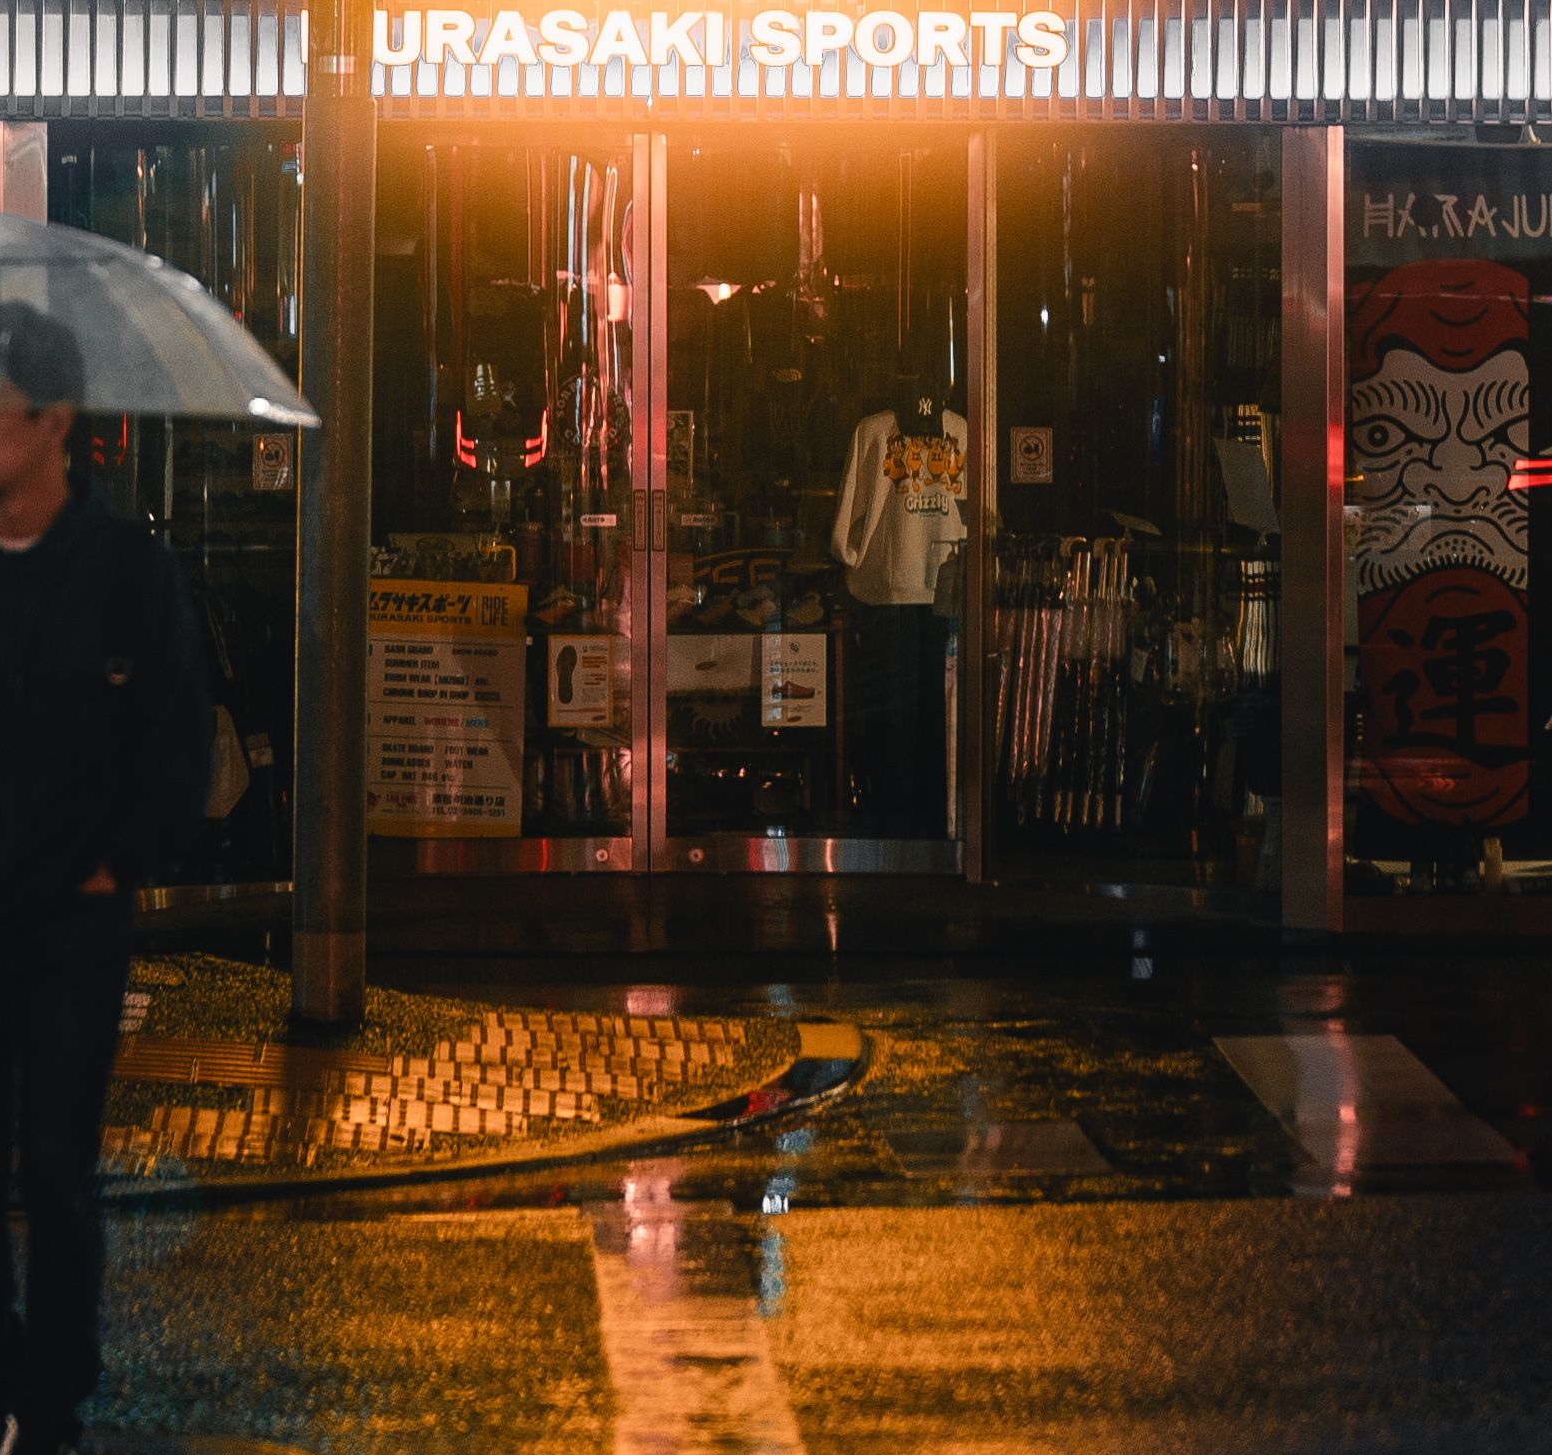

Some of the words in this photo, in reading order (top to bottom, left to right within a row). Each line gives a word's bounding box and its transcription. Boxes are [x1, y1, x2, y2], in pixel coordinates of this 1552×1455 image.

[373, 10, 725, 67] URASAKI
[750, 11, 1069, 68] SPORTS
[904, 494, 949, 514] Grizzly
[481, 596, 509, 610] RIDE
[427, 615, 472, 625] SPORTS
[481, 610, 509, 626] LIFE
[1379, 611, 1530, 759] 運
